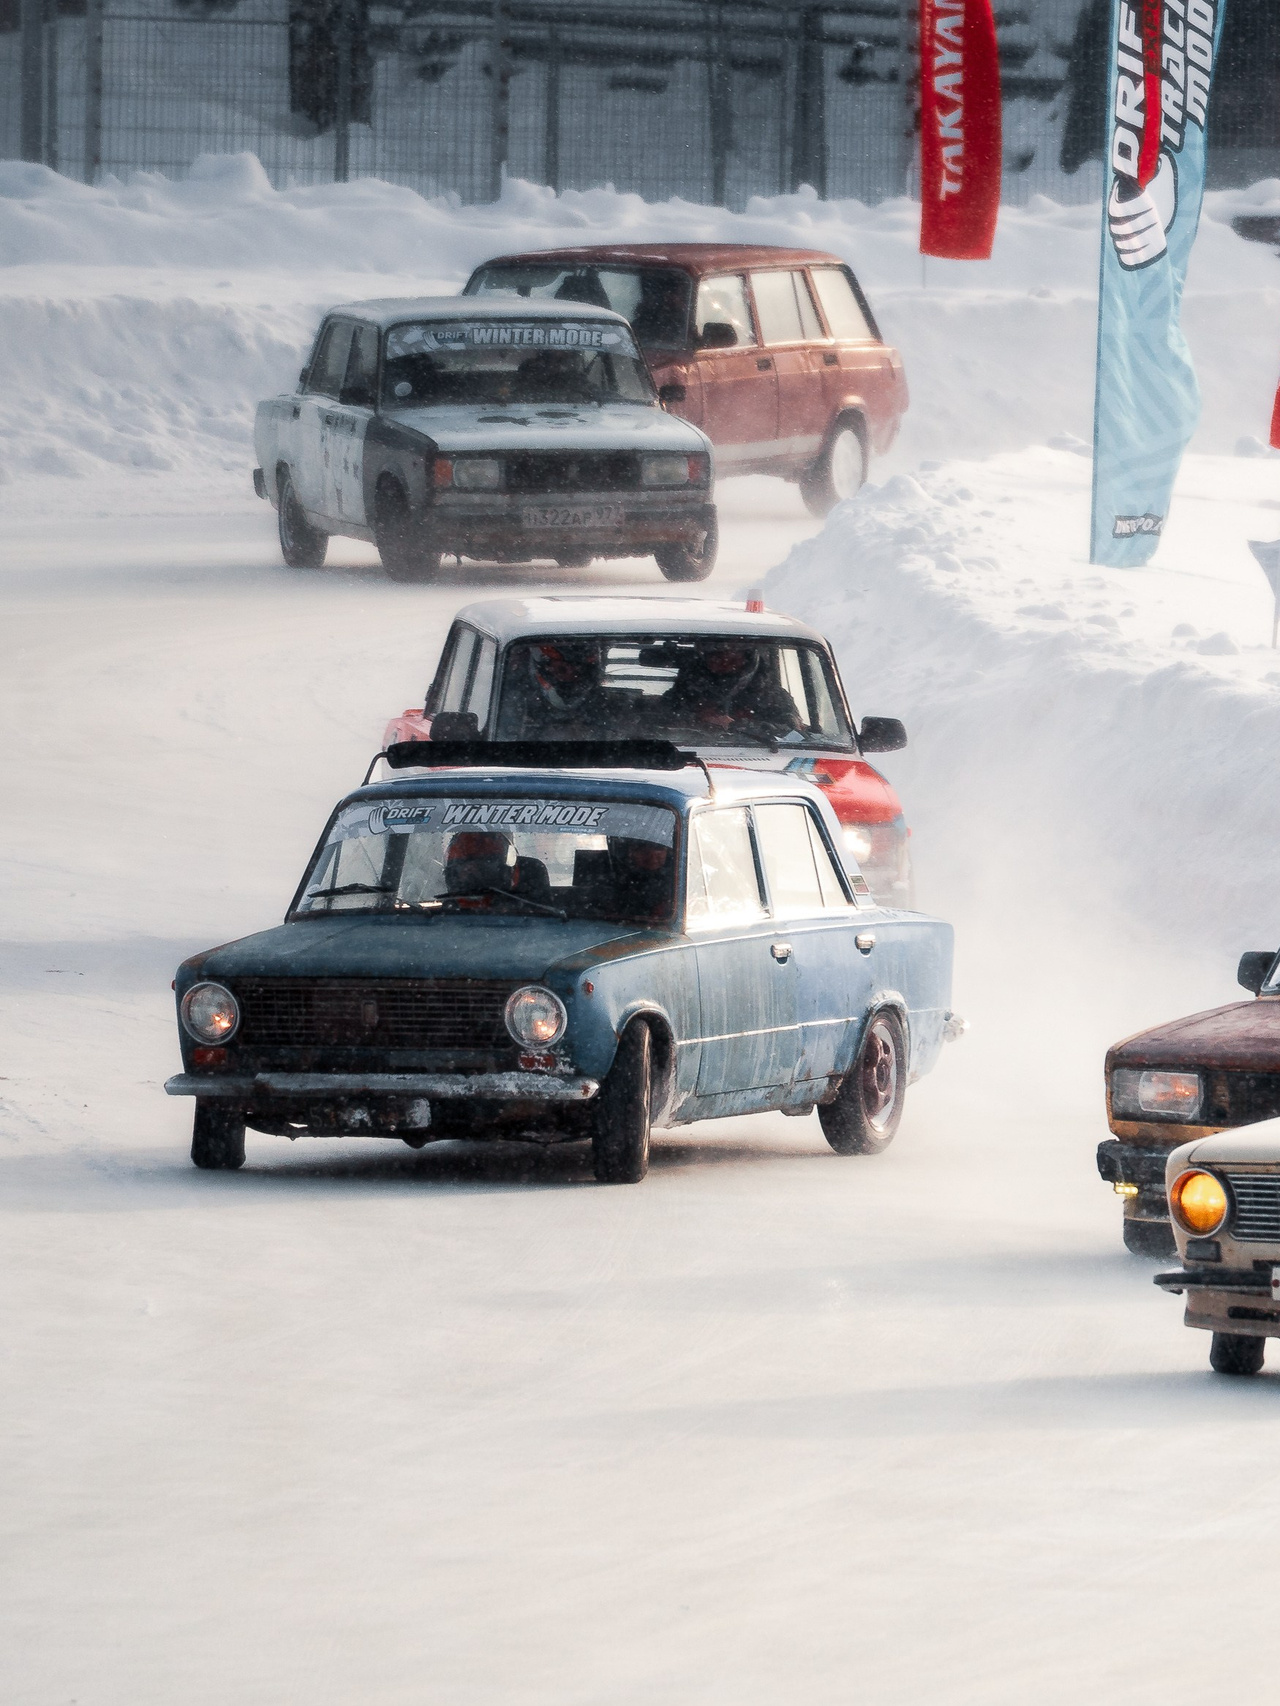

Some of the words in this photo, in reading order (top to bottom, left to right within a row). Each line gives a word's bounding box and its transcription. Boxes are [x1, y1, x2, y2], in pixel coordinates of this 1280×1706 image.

[1112, 0, 1146, 179] DRIF
[1186, 0, 1215, 127] MOD
[437, 331, 471, 340] DRIFT
[472, 328, 547, 346] WINTER
[548, 328, 603, 347] MODE
[386, 806, 436, 819] DRIFT
[534, 805, 610, 827] MODE
